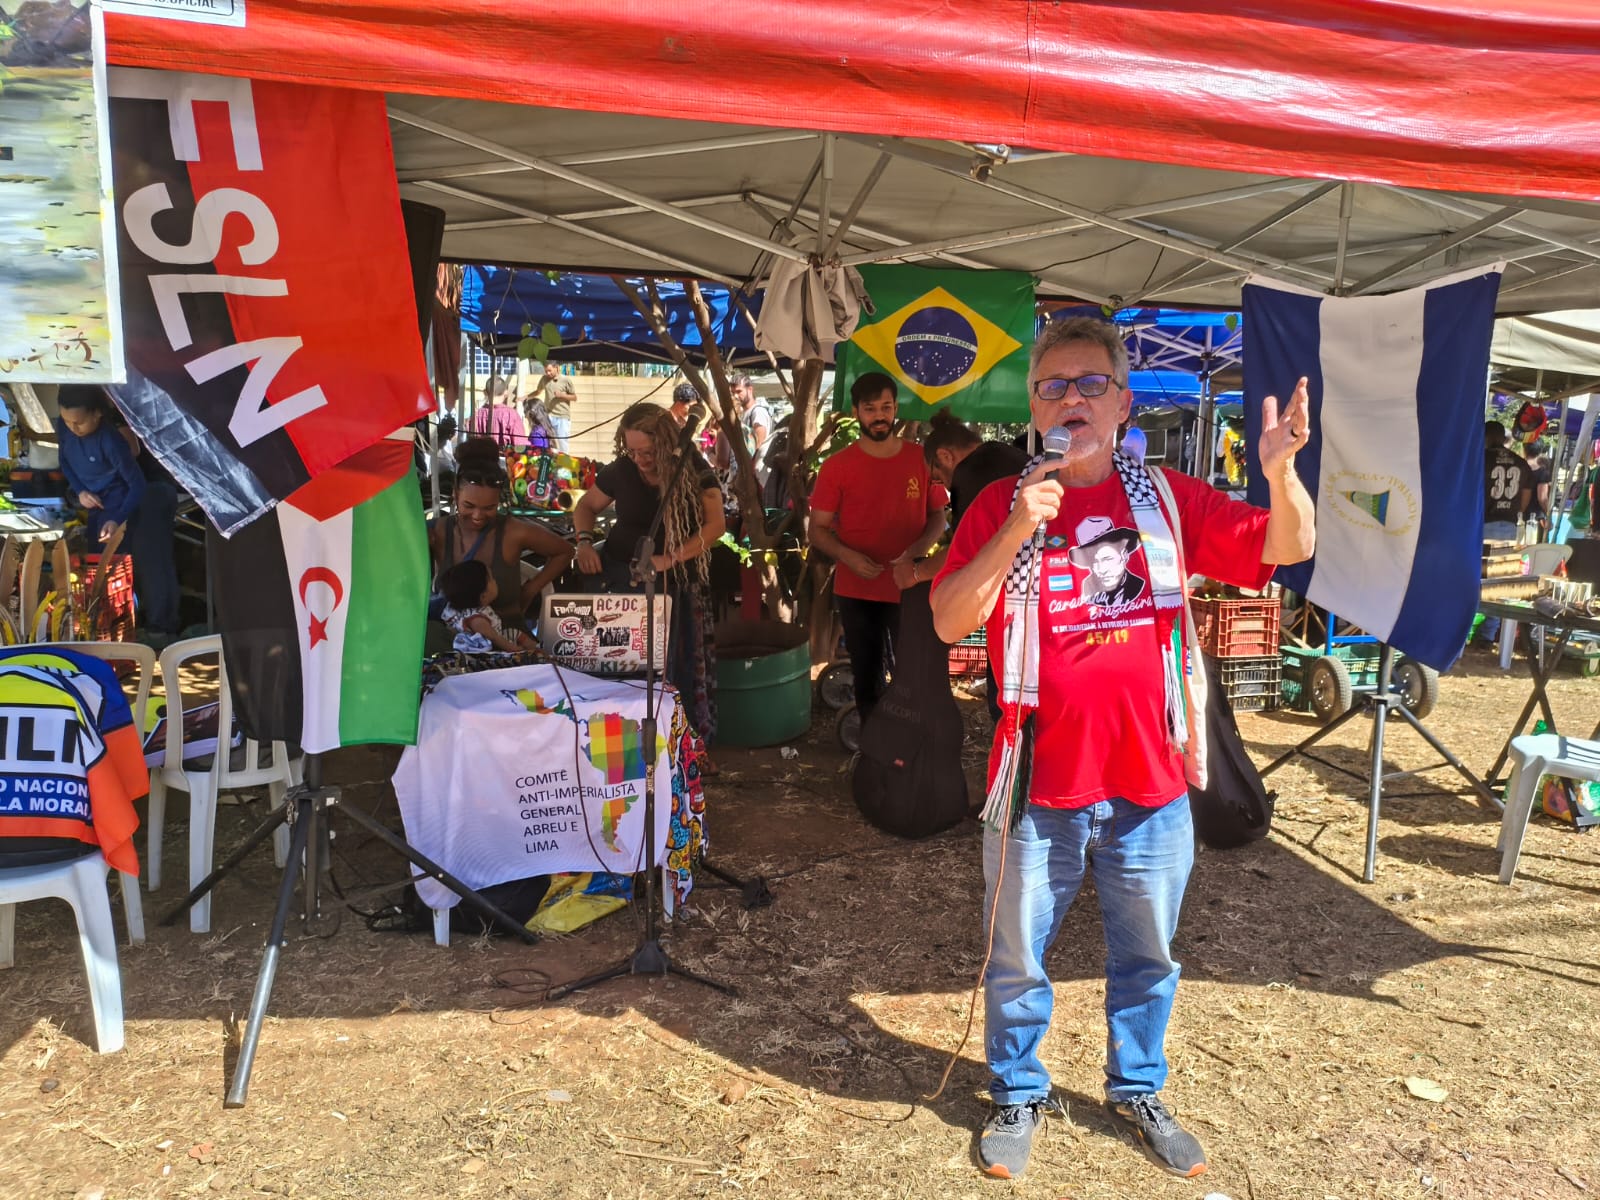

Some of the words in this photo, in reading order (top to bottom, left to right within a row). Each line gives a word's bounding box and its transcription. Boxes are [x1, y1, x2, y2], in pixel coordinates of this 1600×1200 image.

[108, 66, 328, 448] FSLN
[1490, 465, 1521, 500] 33
[1049, 591, 1109, 614] Caravana
[1088, 588, 1153, 620] Brasileira
[1086, 629, 1129, 646] 45/19
[601, 660, 639, 672] KISS
[514, 768, 569, 789] COMITÊ
[518, 782, 636, 804] ANTI-IMPERIALISTA
[520, 804, 582, 820] GENERAL
[523, 821, 568, 838] ABREU
[571, 821, 578, 832] E
[525, 839, 559, 854] LIMA
